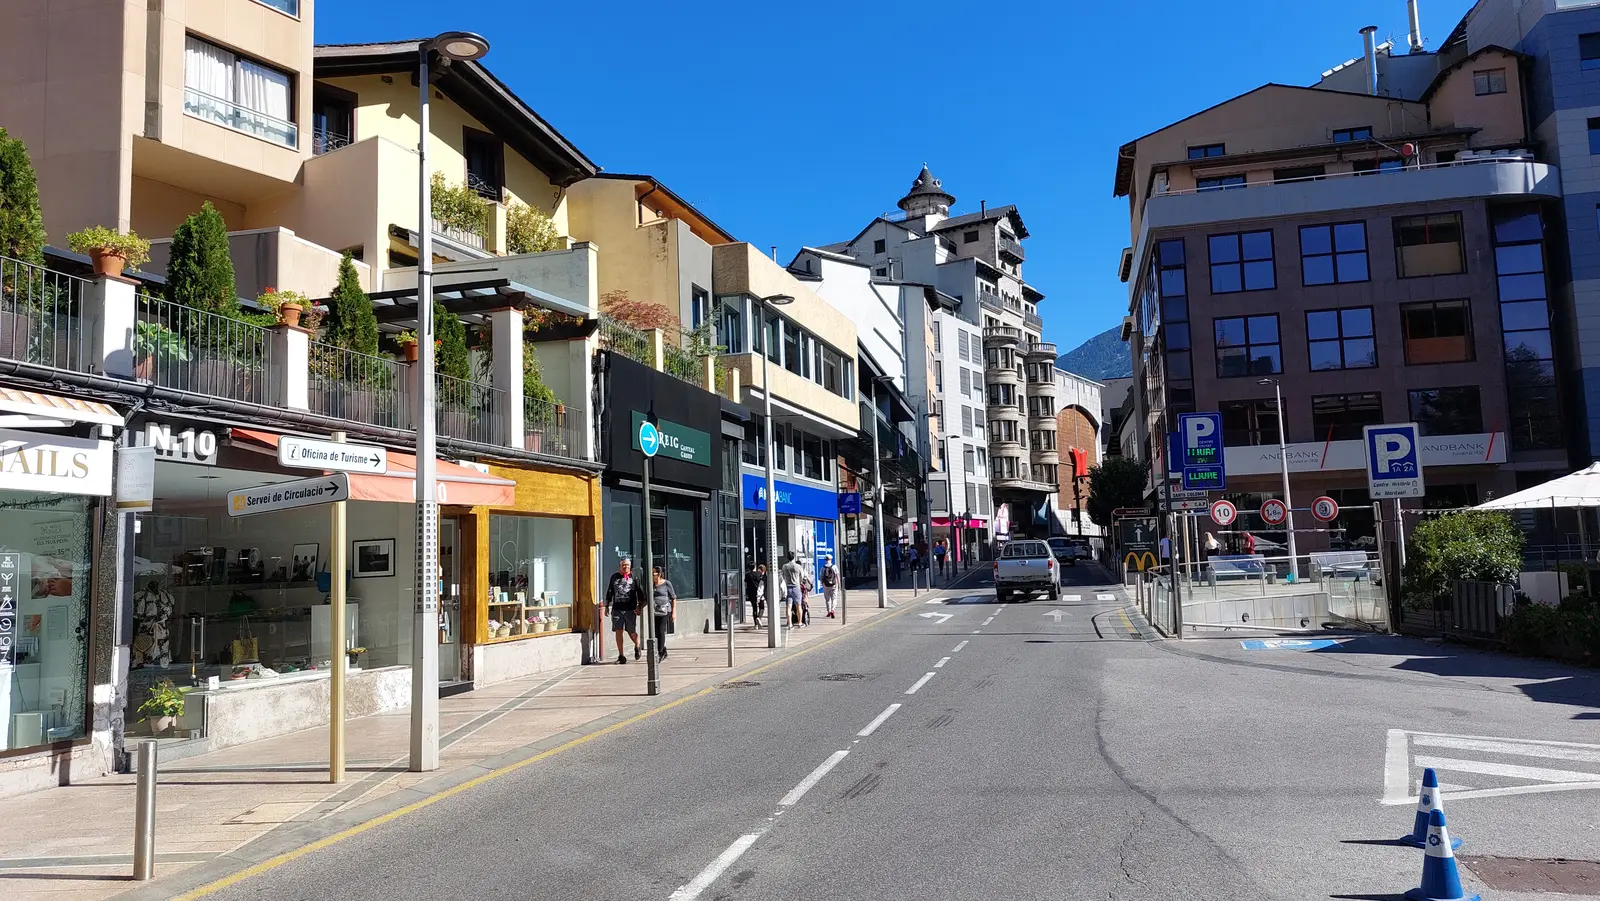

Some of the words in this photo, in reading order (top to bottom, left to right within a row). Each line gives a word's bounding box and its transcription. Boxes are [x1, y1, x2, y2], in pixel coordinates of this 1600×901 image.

[146, 422, 216, 456] N.10
[658, 431, 680, 449] REIG
[1186, 417, 1214, 448] P
[301, 448, 328, 461] Oficina
[329, 451, 339, 461] de
[341, 452, 369, 464] Turisme
[1374, 433, 1411, 474] P
[1421, 443, 1485, 452] ANDBANK
[247, 493, 271, 506] Servei
[272, 492, 282, 503] de
[284, 485, 323, 500] Circulació
[1216, 508, 1230, 518] 10
